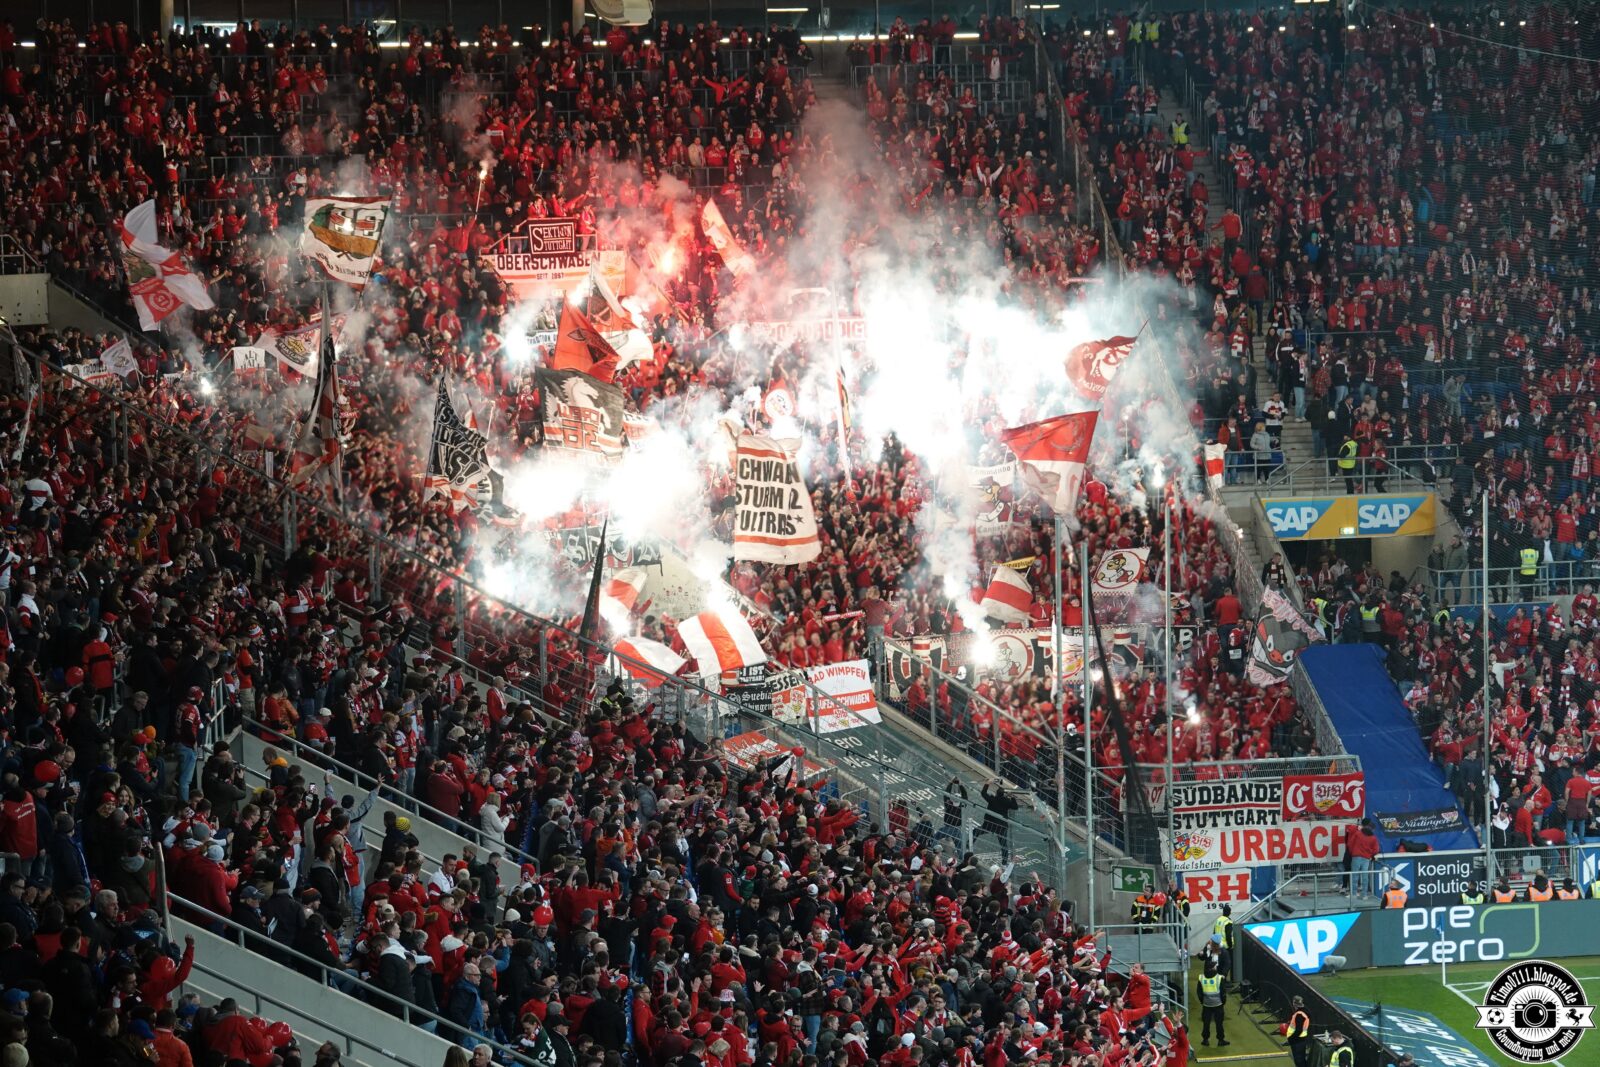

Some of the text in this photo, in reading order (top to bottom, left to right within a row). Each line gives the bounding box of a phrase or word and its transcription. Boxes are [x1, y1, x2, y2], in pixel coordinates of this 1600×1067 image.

[739, 510, 797, 536] ULTRAS
[1267, 507, 1319, 532] SAP
[1358, 503, 1411, 529] SAP
[807, 665, 867, 685] BAD WIMPFEN
[1172, 782, 1281, 807] SÜDBANDE
[1172, 808, 1280, 830] STUTTGART
[1162, 860, 1222, 870] Gndelsheim
[1185, 873, 1251, 904] RH
[1403, 905, 1475, 938] pre
[1403, 938, 1504, 965] zero
